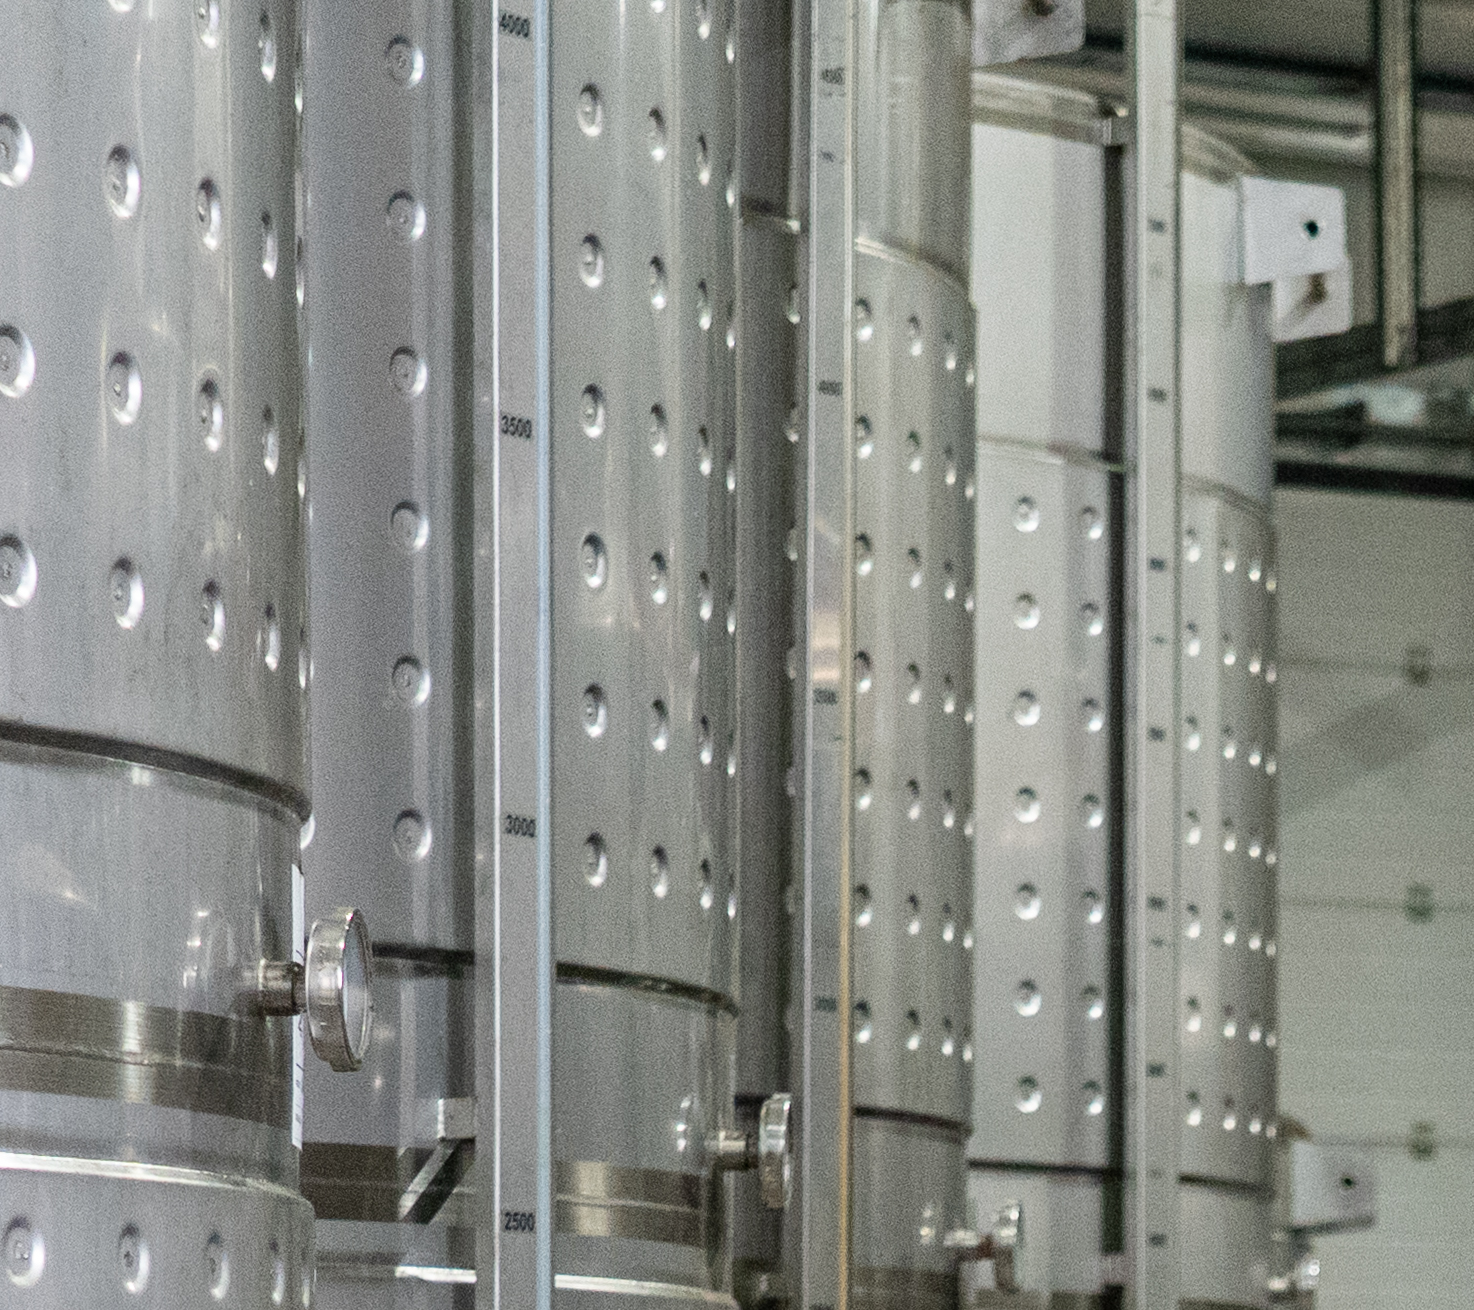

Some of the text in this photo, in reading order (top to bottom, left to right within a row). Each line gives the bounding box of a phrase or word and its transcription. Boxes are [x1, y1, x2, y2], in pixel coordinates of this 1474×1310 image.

[499, 13, 530, 38] 4000
[501, 414, 532, 439] 3500
[505, 814, 536, 838] 3000
[504, 1211, 535, 1232] 2500
